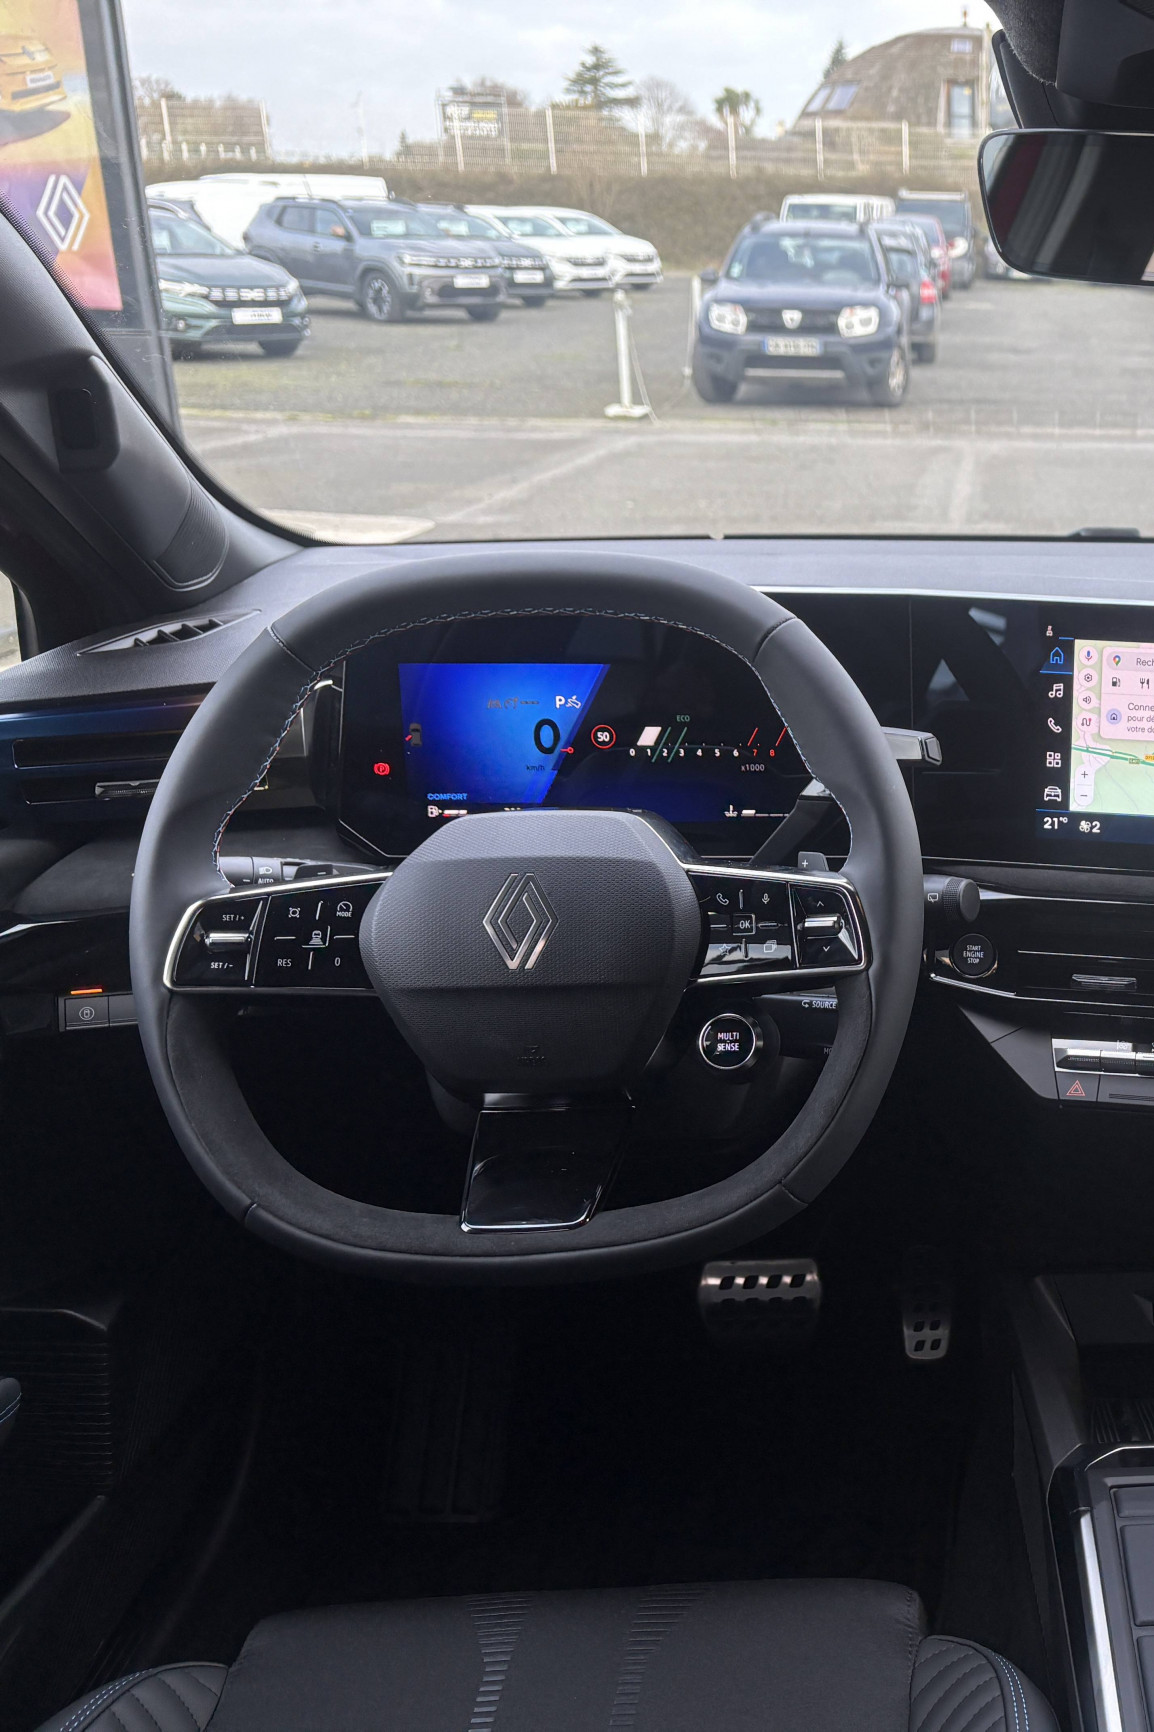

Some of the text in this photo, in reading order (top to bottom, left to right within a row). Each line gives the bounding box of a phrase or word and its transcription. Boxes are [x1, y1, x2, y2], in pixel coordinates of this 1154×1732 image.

[555, 695, 566, 709] P
[676, 714, 691, 722] ECO
[1127, 714, 1145, 723] pour
[533, 718, 561, 755] 0
[597, 731, 610, 742] 50
[526, 764, 546, 772] km/h
[741, 763, 765, 772] x1000
[427, 792, 468, 800] COMFORT
[1091, 820, 1101, 833] 2
[739, 920, 751, 929] OK
[277, 958, 292, 967] RES
[812, 1000, 837, 1009] SOURCE
[717, 1032, 740, 1041] MULTI
[717, 1042, 740, 1051] SENSE
